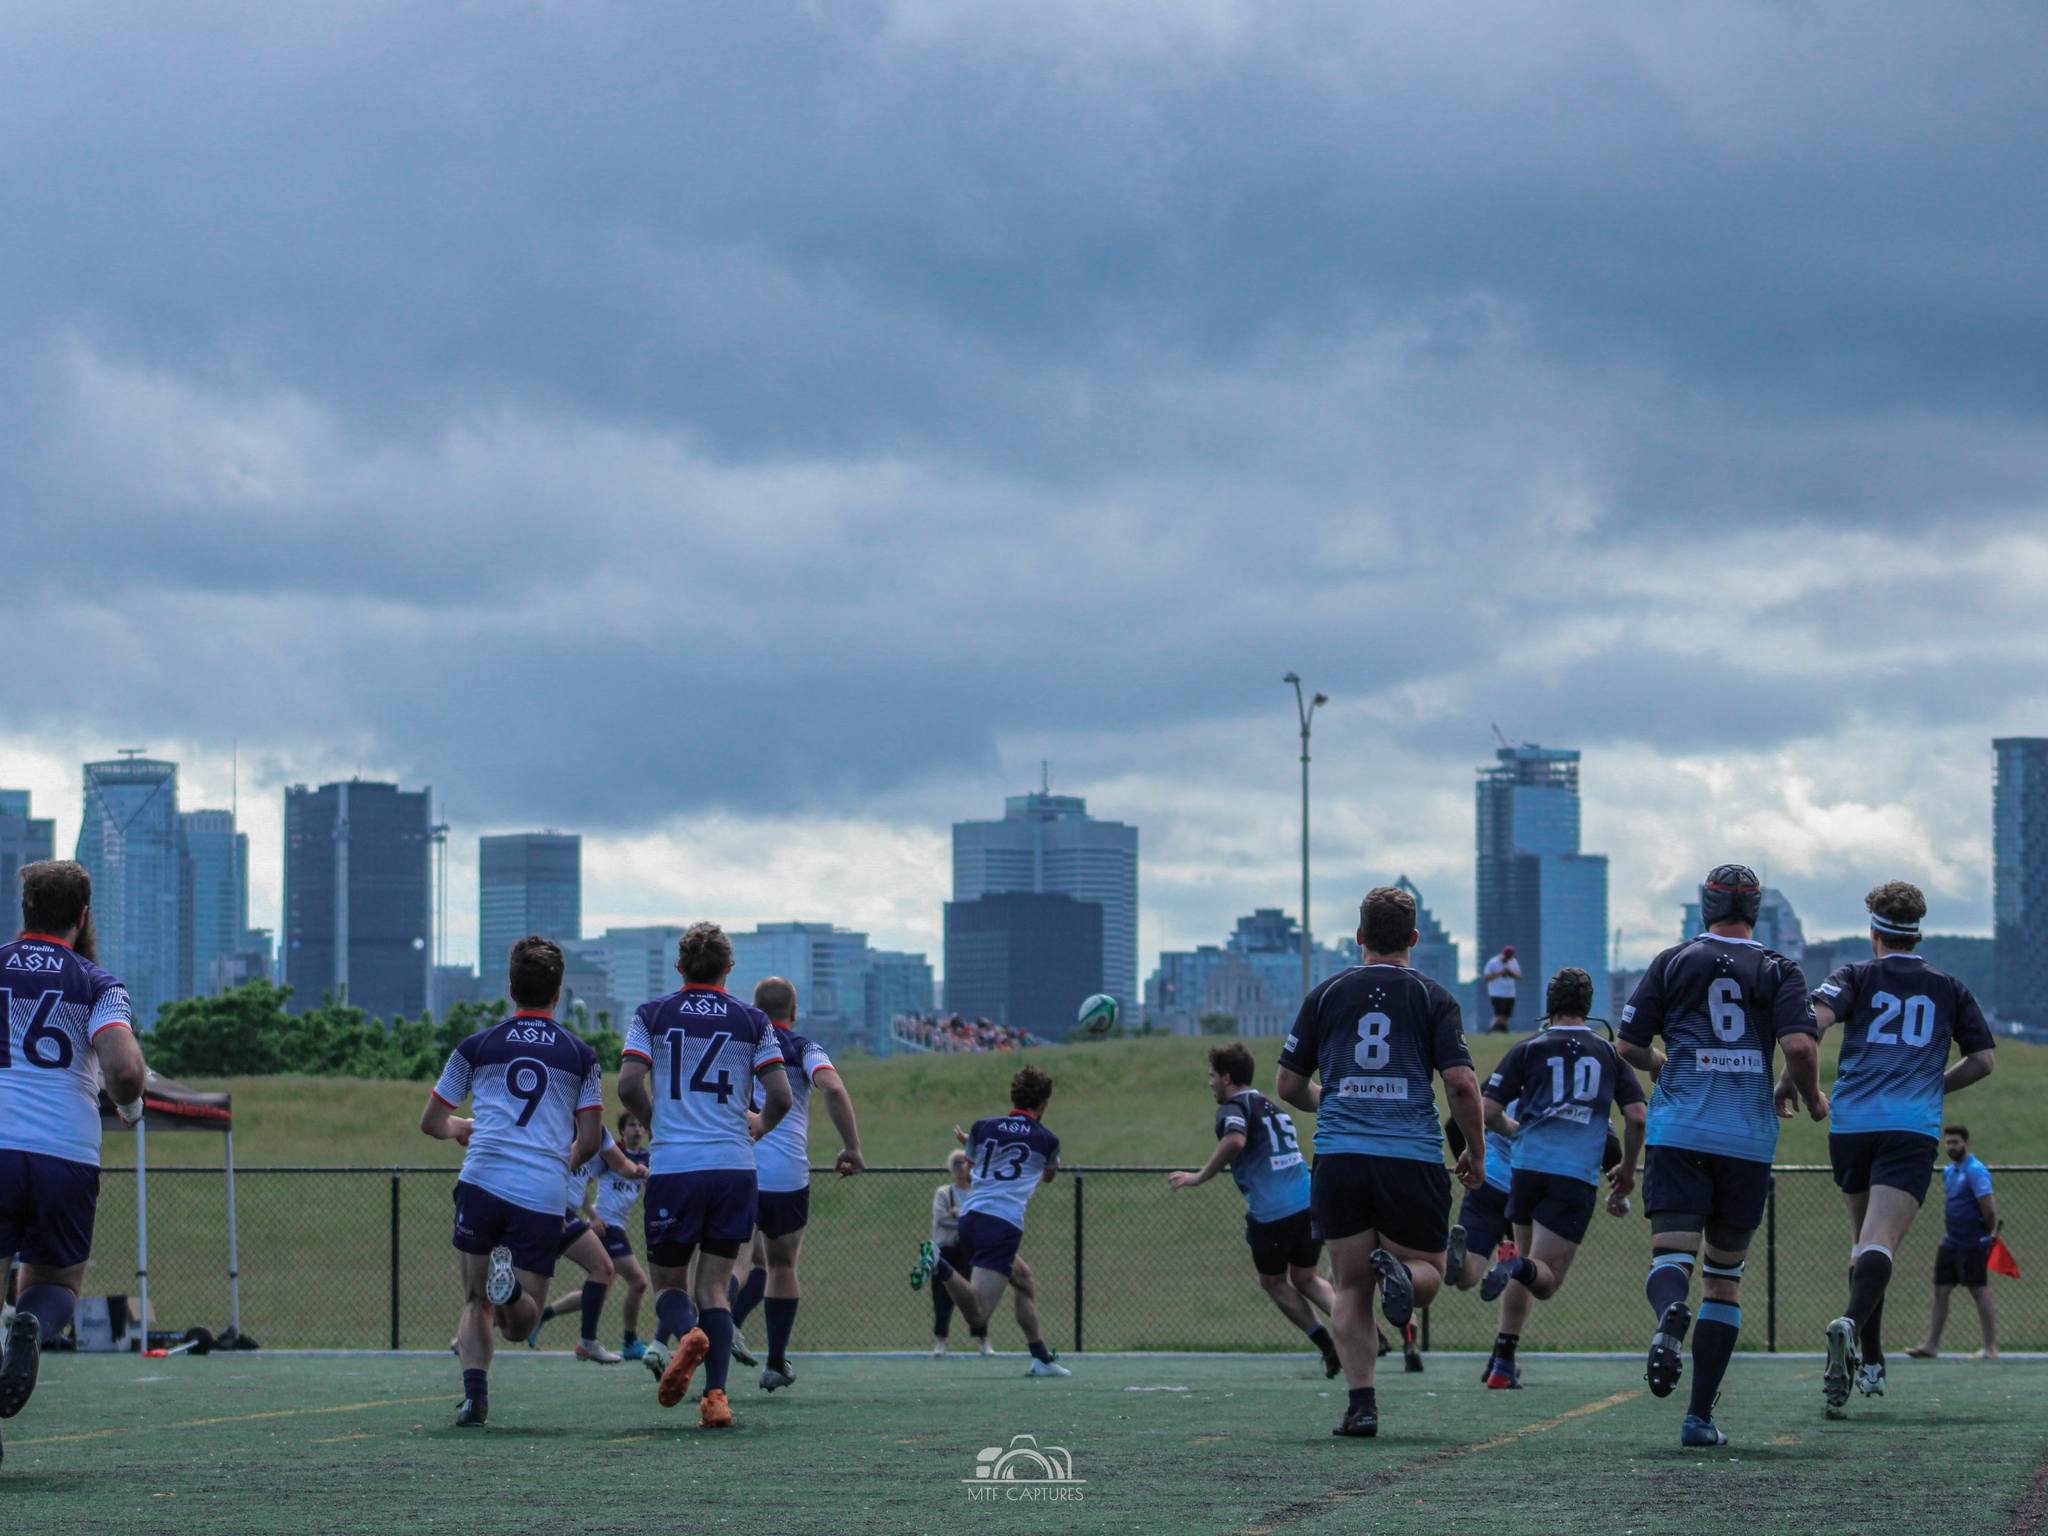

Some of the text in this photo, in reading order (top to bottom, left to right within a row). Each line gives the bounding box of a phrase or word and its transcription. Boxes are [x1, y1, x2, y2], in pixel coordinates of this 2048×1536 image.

[0, 987, 74, 1070] 16
[1707, 977, 1746, 1043] 6
[1866, 990, 1936, 1048] 20
[664, 1027, 734, 1105] 14
[1354, 1011, 1392, 1070] 8
[504, 1056, 550, 1128] 9
[1546, 1055, 1602, 1104] 10
[980, 1137, 1032, 1181] 13
[1261, 1113, 1299, 1153] 15
